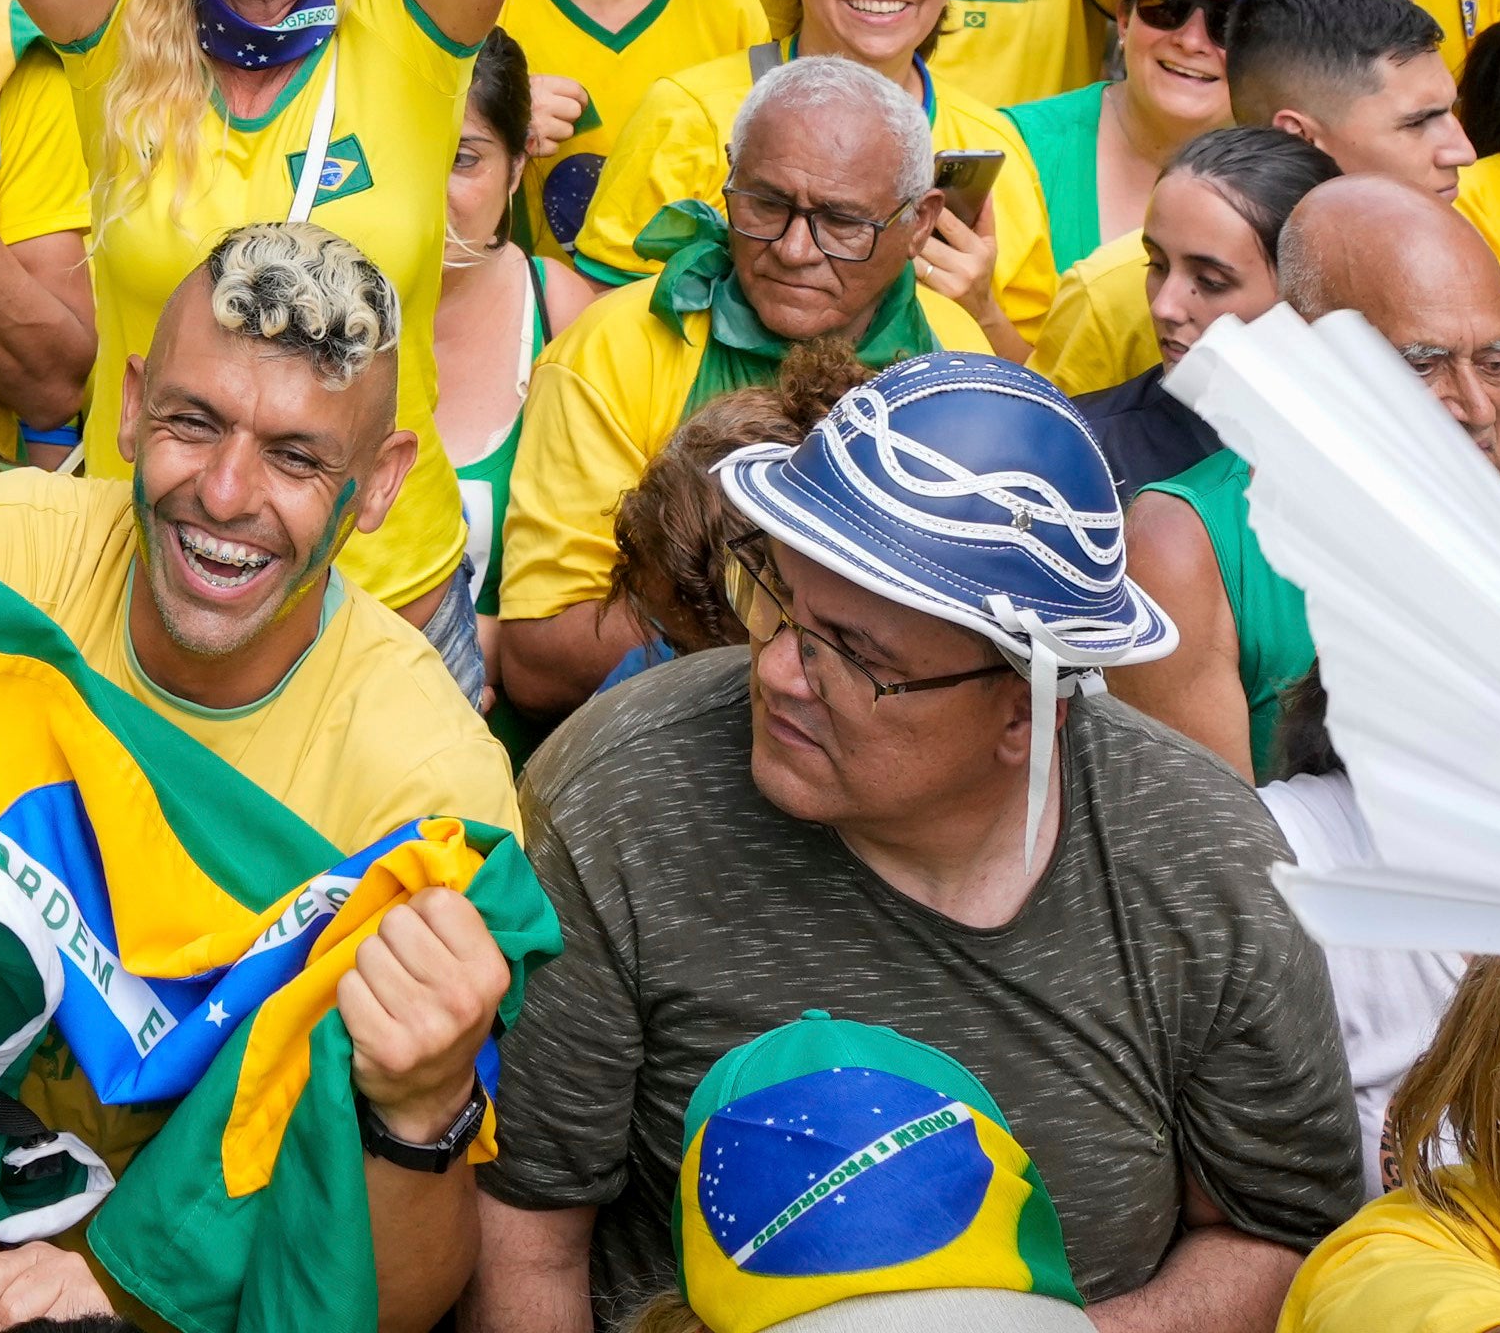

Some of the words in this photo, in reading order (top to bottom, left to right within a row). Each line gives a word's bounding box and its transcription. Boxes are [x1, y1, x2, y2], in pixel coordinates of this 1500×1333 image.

[275, 7, 335, 29] GRESSO
[894, 1108, 958, 1147] ORDEM
[751, 1149, 878, 1251] PROGRESSO
